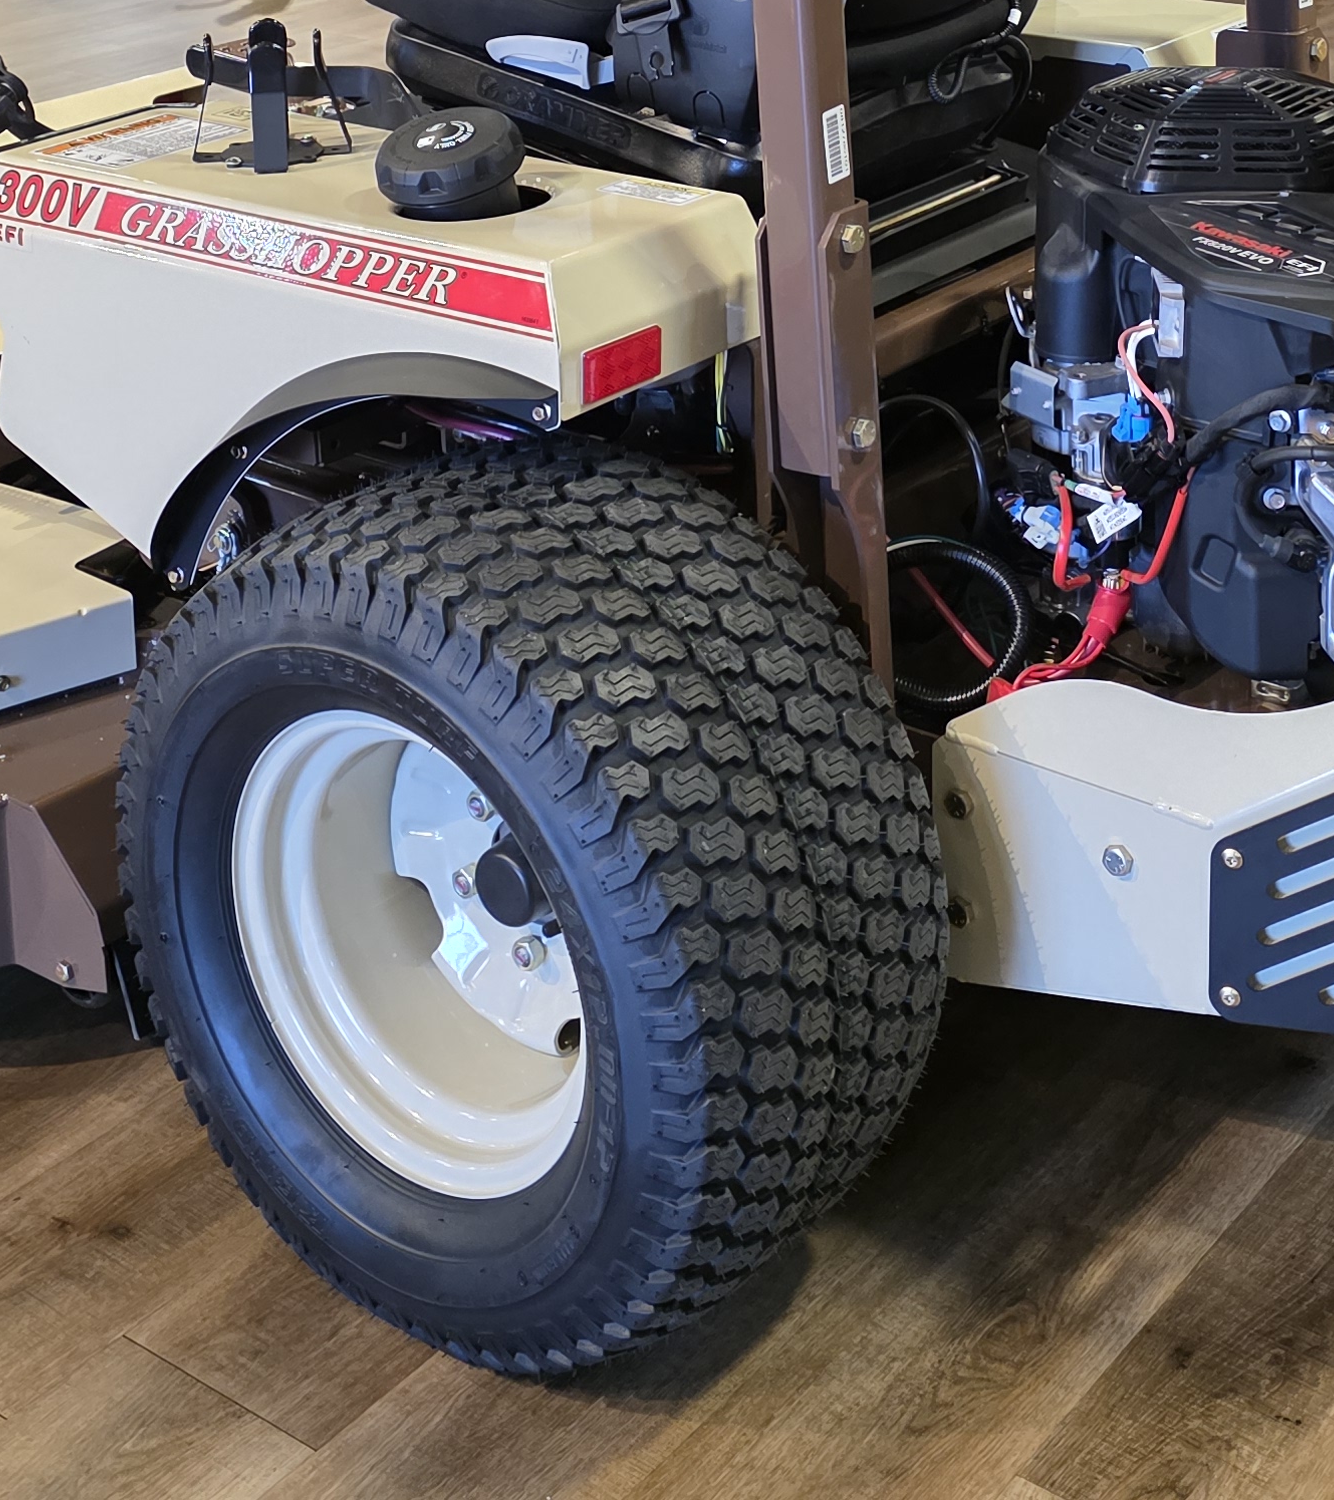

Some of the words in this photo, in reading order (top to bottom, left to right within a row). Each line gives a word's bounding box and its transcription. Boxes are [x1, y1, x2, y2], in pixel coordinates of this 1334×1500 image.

[1190, 220, 1294, 259] Kawasaki
[120, 202, 459, 306] GRASSHOPPER
[1236, 249, 1275, 266] EVO
[1285, 257, 1320, 273] EFI
